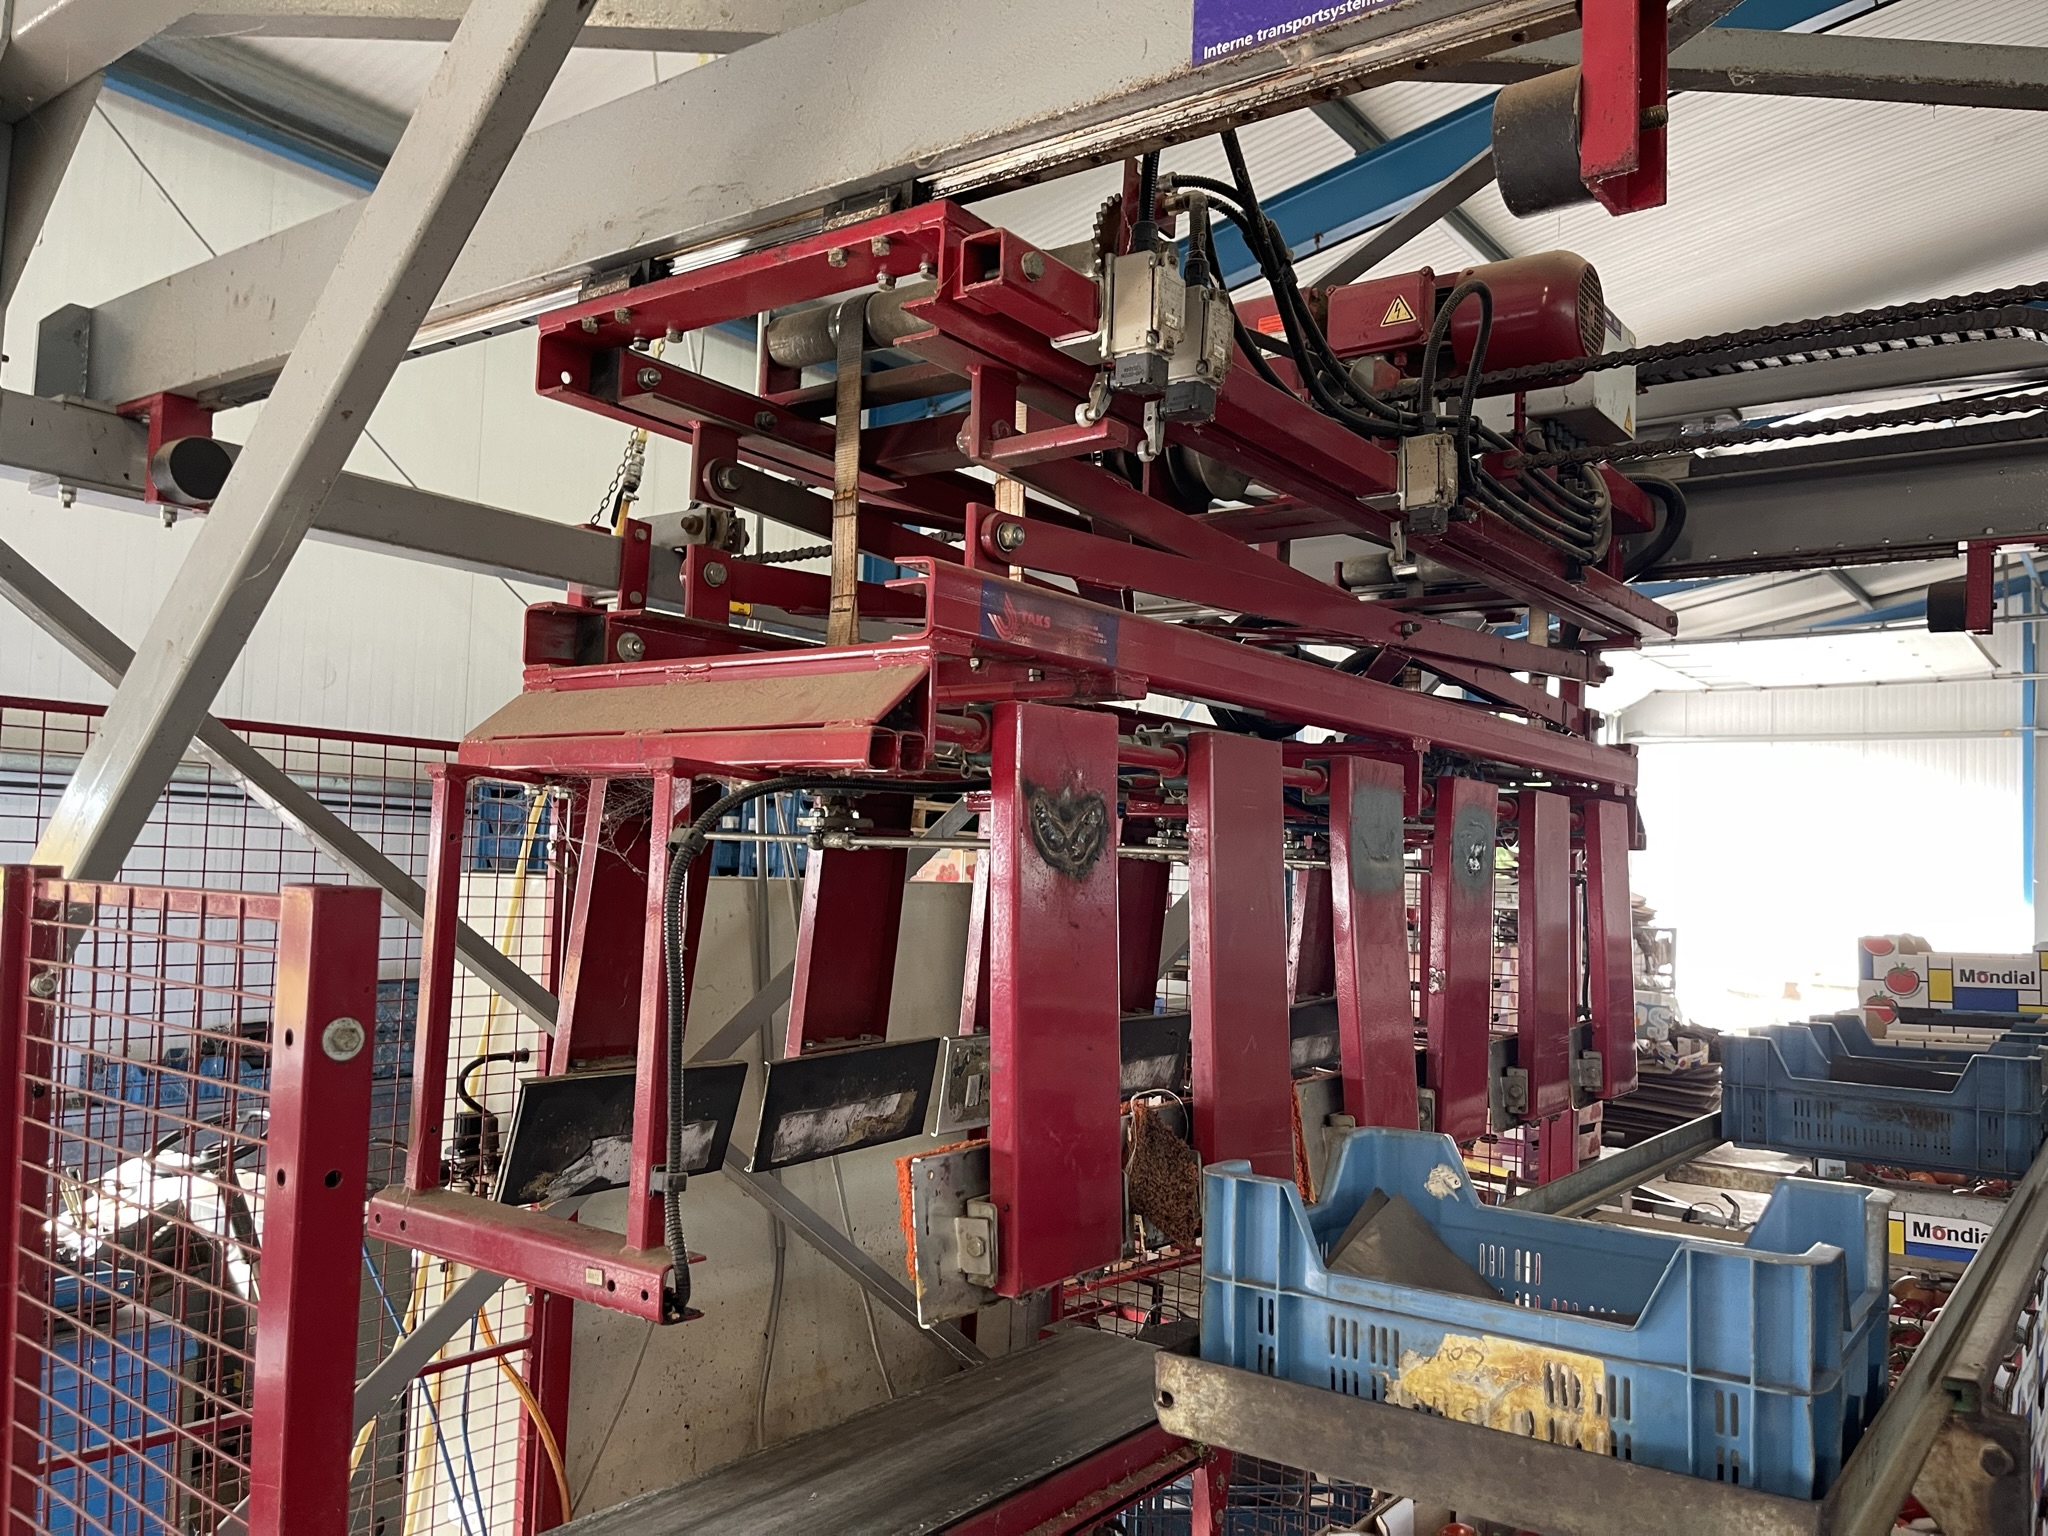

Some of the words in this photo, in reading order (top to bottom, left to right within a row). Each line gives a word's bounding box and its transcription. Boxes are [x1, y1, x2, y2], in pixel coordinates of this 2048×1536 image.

[1203, 33, 1253, 59] Interne
[1256, 0, 1384, 41] transportsystem
[1019, 610, 1051, 628] TAKS
[1959, 968, 2035, 985] Mondial
